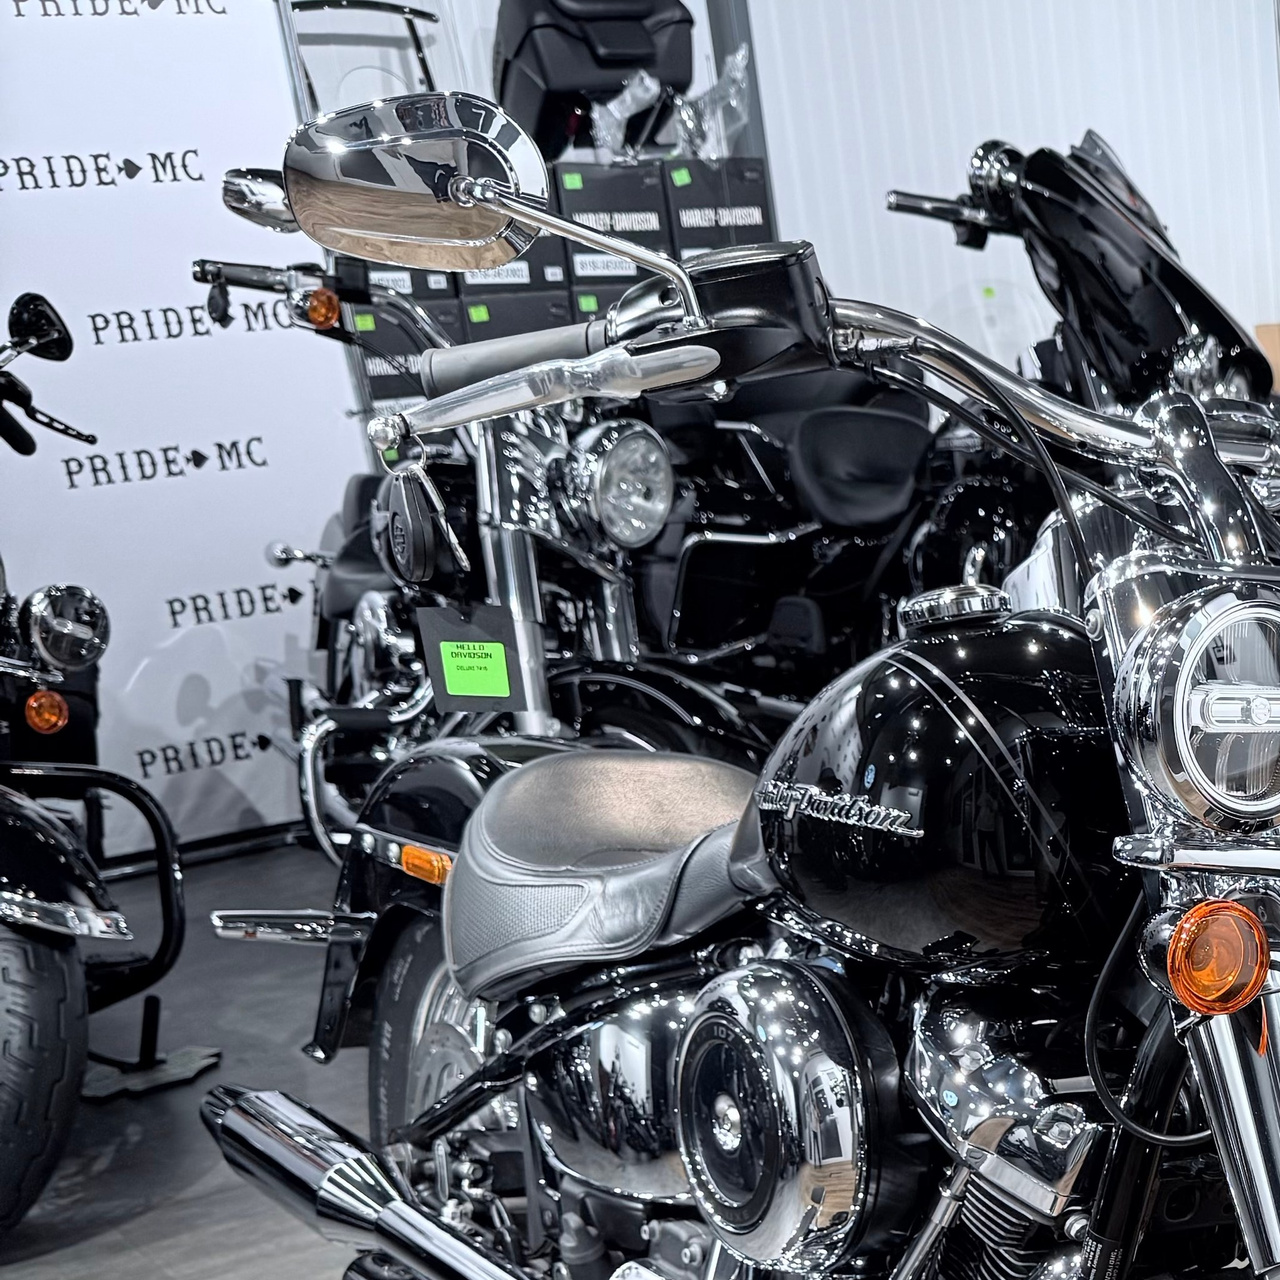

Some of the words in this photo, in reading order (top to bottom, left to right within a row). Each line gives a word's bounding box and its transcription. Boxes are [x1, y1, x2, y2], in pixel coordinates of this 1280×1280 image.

[147, 149, 205, 183] MC
[87, 305, 212, 345] PRIDE
[241, 300, 295, 332] MC
[61, 444, 188, 490] PRIDE
[214, 437, 268, 472] MC
[166, 582, 282, 629] PRIDE
[138, 732, 255, 779] PRIDE
[713, 1025, 735, 1042] 107
